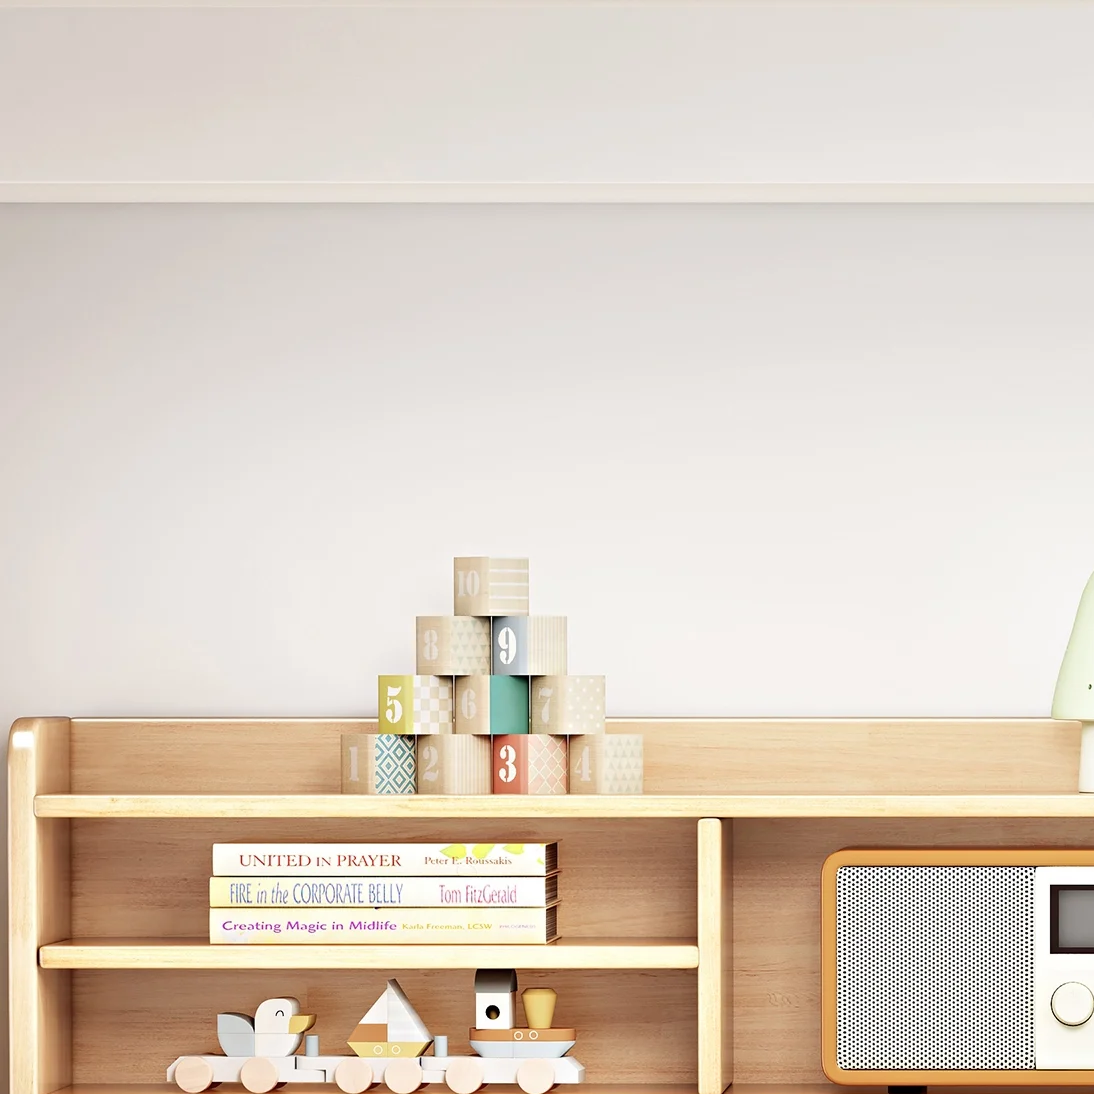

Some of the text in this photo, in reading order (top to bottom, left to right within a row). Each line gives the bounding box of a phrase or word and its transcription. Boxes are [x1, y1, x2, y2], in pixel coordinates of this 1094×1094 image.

[457, 570, 480, 597] 10
[423, 628, 439, 661] 8
[497, 626, 517, 665] 9
[385, 685, 403, 724] 5
[461, 687, 477, 720] 6
[538, 686, 554, 723] 7
[348, 746, 360, 781] 1
[422, 746, 439, 781] 2
[499, 744, 517, 783] 3
[574, 746, 592, 781] 4
[239, 854, 311, 867] UNITED
[337, 854, 402, 867] PRAYER
[424, 856, 513, 866] Peter E. Roussakis
[229, 882, 403, 904] FIRE in the CORPORATE BELLY
[438, 885, 518, 904] Tom FitzGerald
[222, 920, 397, 933] Creating Magic in Midlife
[426, 924, 465, 932] Freeman,
